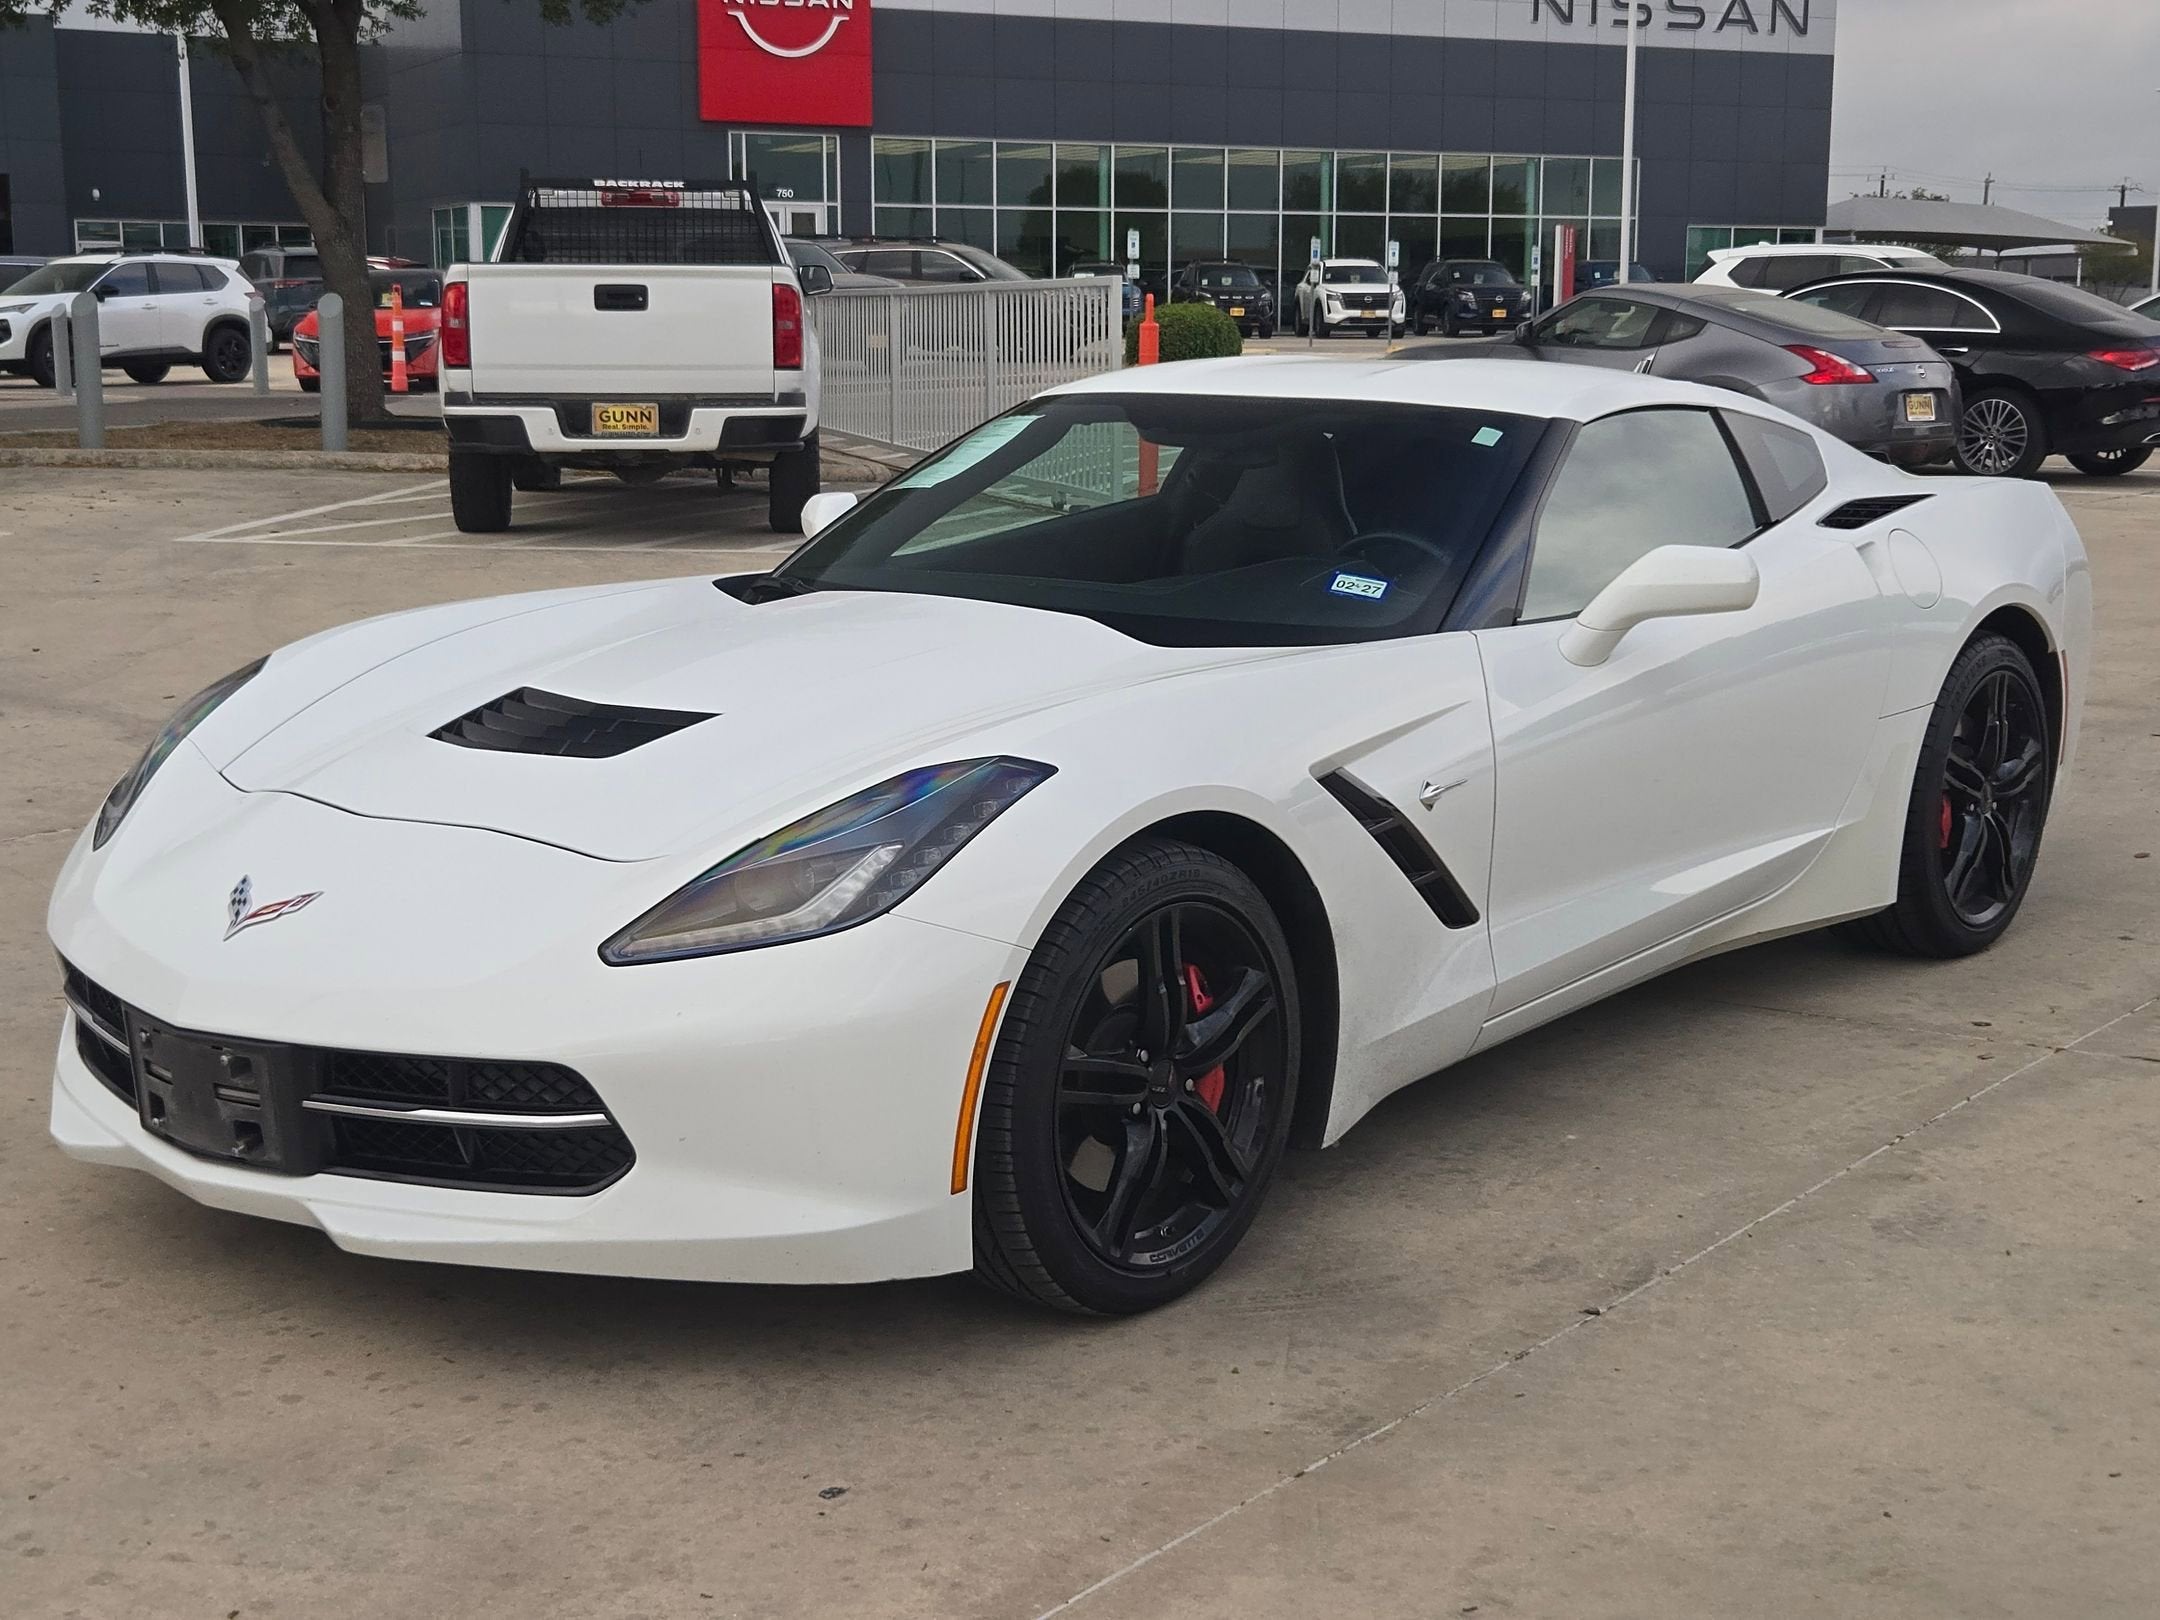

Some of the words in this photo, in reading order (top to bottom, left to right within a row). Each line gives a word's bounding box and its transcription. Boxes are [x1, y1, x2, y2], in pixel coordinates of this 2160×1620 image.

[593, 179, 685, 188] BACKRACK
[775, 188, 794, 198] 750
[598, 410, 653, 423] GUNN
